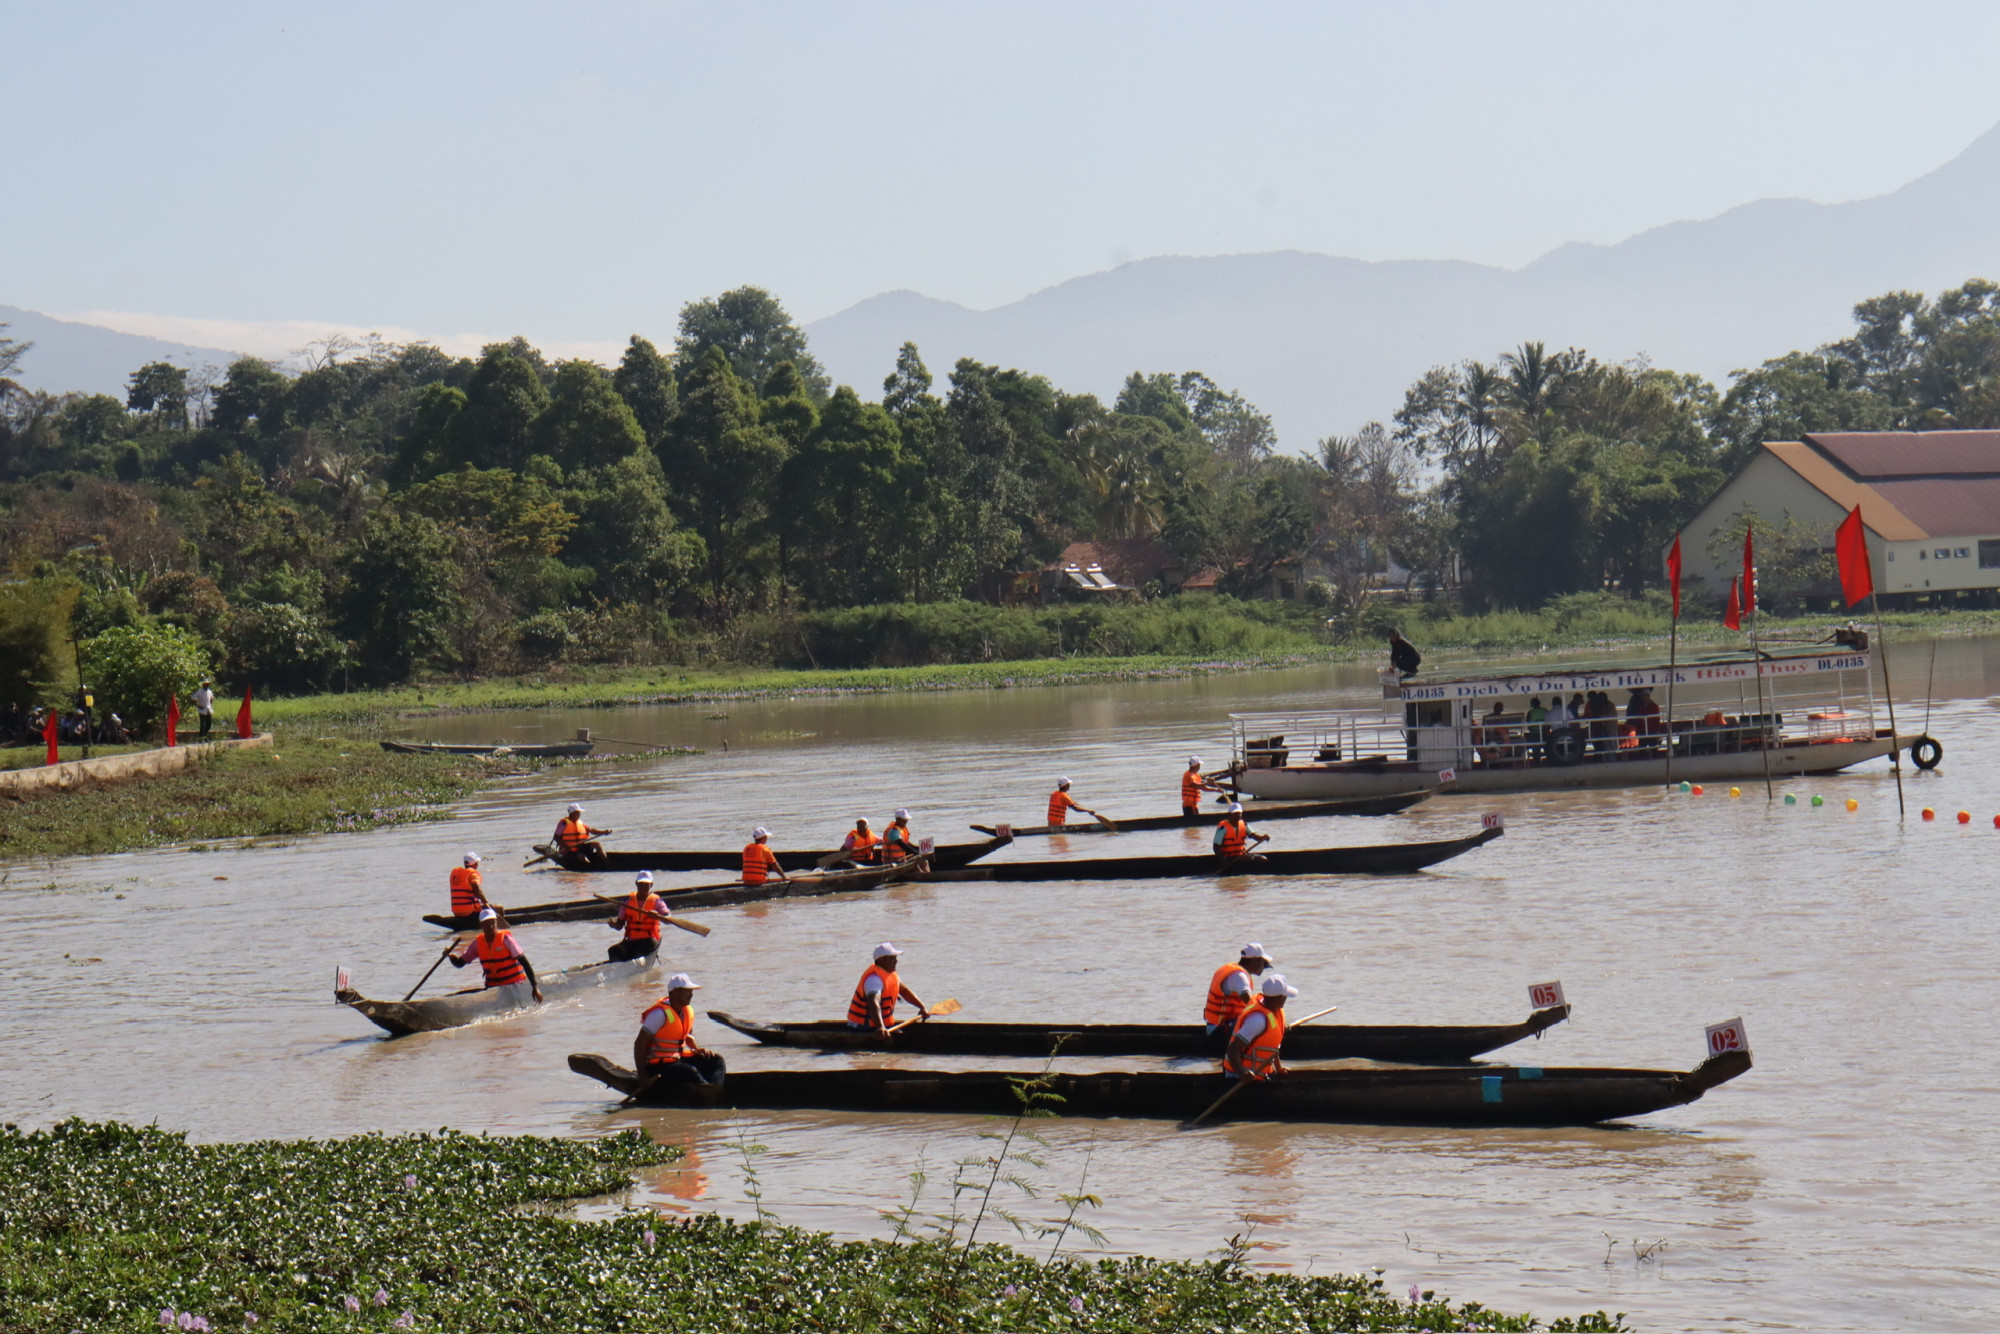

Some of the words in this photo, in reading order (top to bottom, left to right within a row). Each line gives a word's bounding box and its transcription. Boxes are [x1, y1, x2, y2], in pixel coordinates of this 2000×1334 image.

[1457, 685, 1498, 698] Dịch
[1505, 680, 1531, 694] Vụ
[1539, 681, 1563, 691] Du
[1571, 677, 1611, 690] Lịch
[1618, 671, 1644, 686] Hồ
[1441, 770, 1452, 781] 08
[1484, 814, 1498, 826] 07
[998, 826, 1009, 838] 09
[920, 841, 932, 852] 06
[1533, 986, 1557, 1006] 05
[1712, 1028, 1739, 1052] 02
